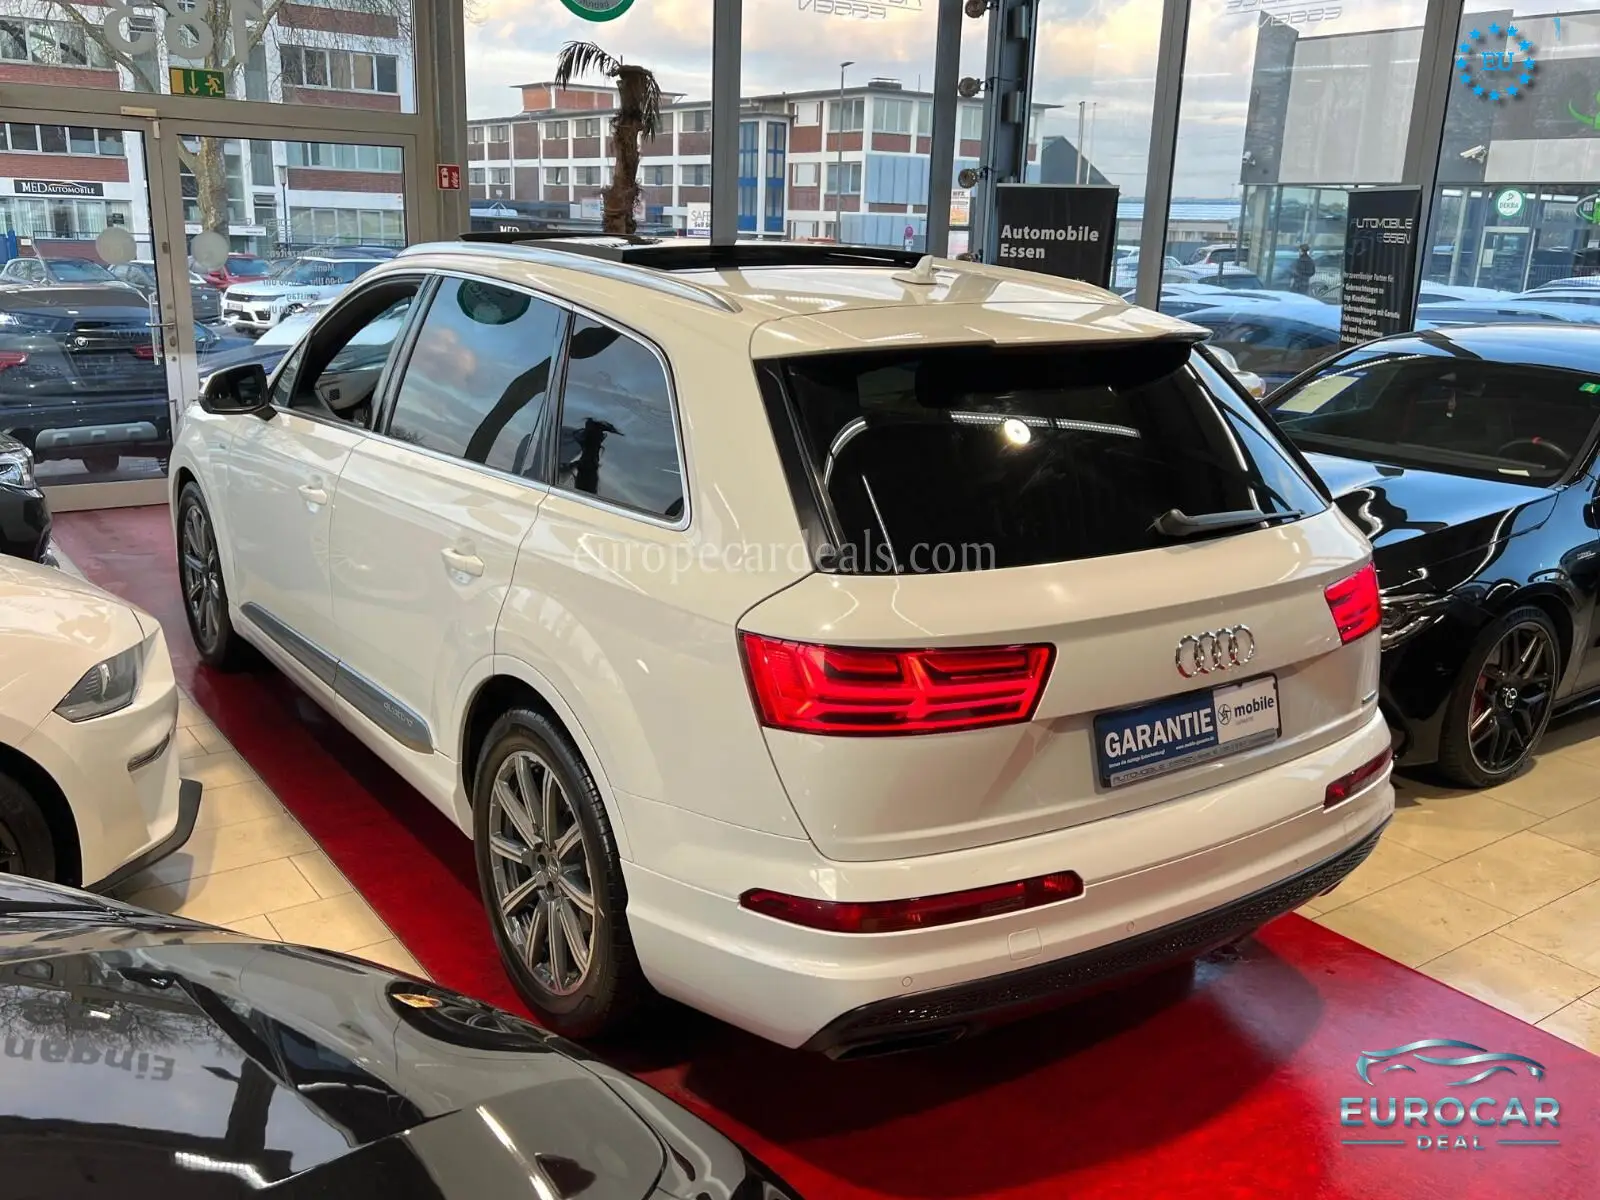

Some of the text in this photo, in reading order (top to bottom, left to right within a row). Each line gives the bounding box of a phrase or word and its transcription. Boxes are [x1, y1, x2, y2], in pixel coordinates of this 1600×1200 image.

[20, 182, 47, 193] MED
[1000, 224, 1099, 242] Automobile
[1000, 243, 1045, 259] Essen
[1234, 696, 1274, 718] mobile
[1104, 707, 1214, 758] GARANTIE
